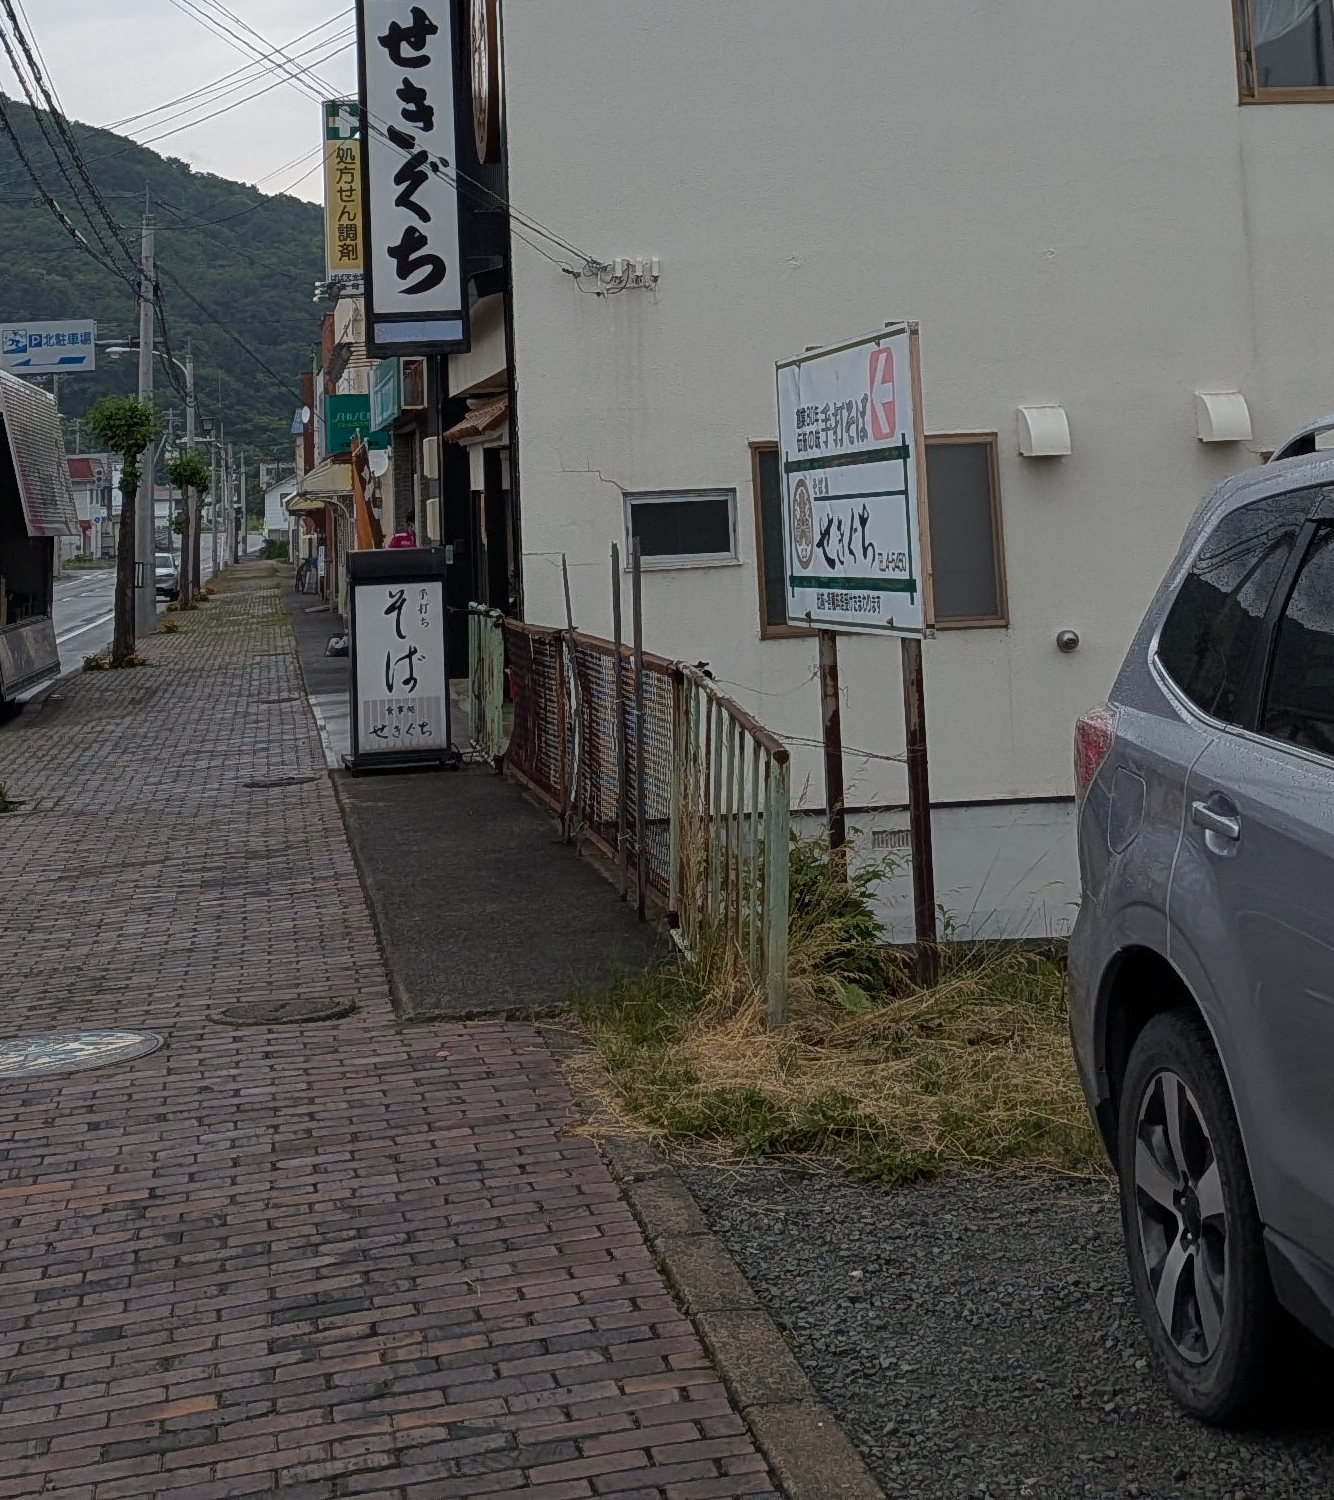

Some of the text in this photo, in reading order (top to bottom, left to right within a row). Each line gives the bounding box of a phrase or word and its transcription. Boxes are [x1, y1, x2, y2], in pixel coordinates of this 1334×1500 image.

[378, 5, 447, 295] せきぐち
[335, 146, 359, 262] 処方せん調剤
[43, 331, 92, 347] 北駐車場
[820, 393, 869, 450] 手打そば
[418, 588, 430, 628] 手打ち
[384, 588, 426, 694] そば
[369, 722, 433, 740] せきぐち
